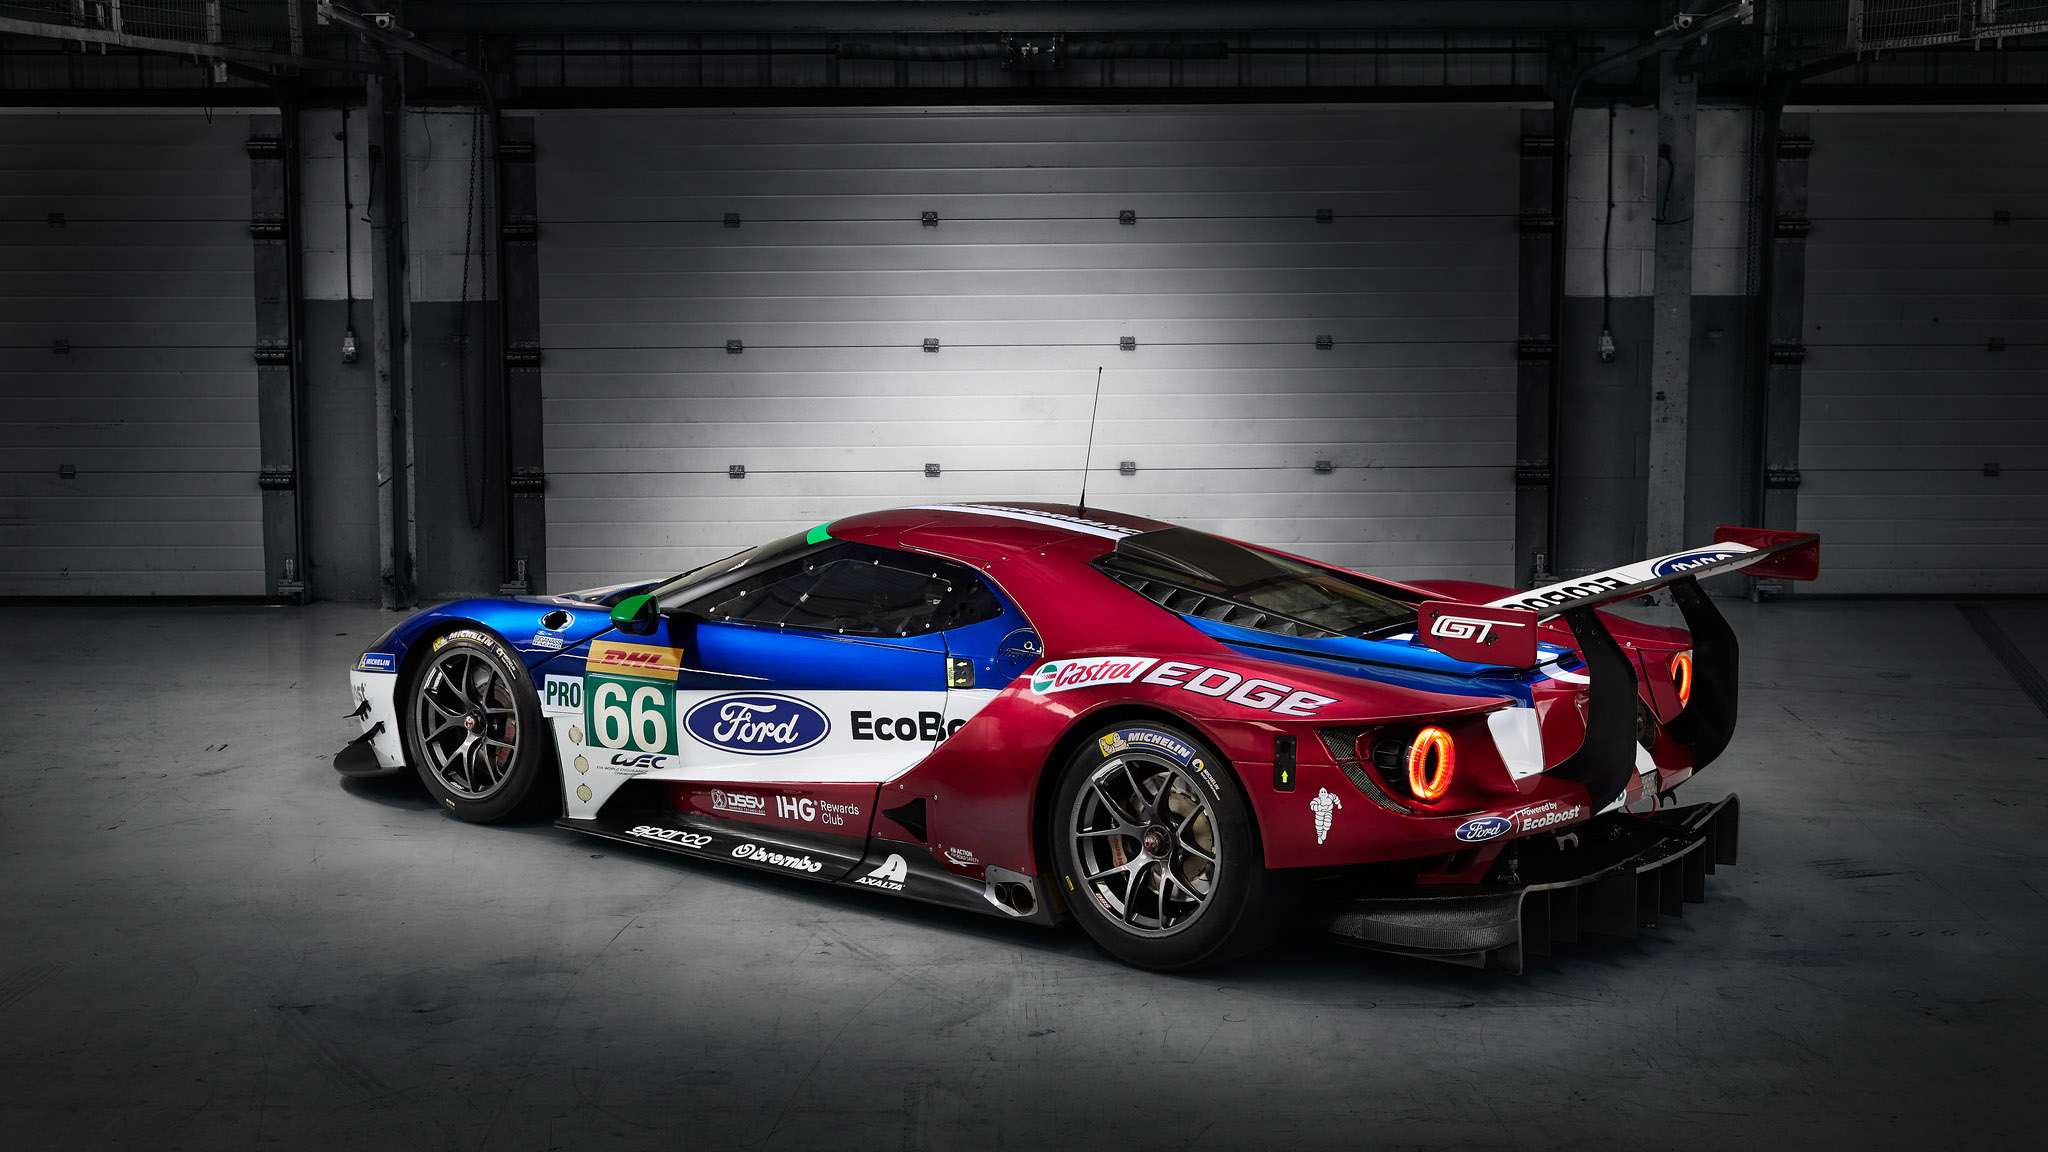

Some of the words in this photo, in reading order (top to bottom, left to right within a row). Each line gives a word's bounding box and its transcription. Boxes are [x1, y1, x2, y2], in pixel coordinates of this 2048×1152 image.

[448, 630, 495, 647] MICHELIN
[1431, 615, 1525, 644] GT
[601, 649, 676, 671] DHL
[546, 681, 581, 708] PRO
[1055, 659, 1144, 688] Castrol
[1141, 661, 1343, 716] EDGE
[594, 682, 668, 753] 66
[713, 701, 799, 744] Ford
[1128, 733, 1191, 758] MICHELIN
[611, 753, 668, 769] WEC
[727, 793, 765, 809] DSSV
[776, 795, 816, 822] IHG
[821, 800, 860, 815] Rewards
[822, 814, 844, 826] Club
[1466, 820, 1501, 839] Ford
[1521, 803, 1549, 816] Powered
[1549, 802, 1557, 811] by
[1522, 806, 1580, 831] EcoBoost
[626, 826, 712, 848] sparco
[749, 847, 823, 873] brembo
[855, 876, 904, 891] AXALTA
